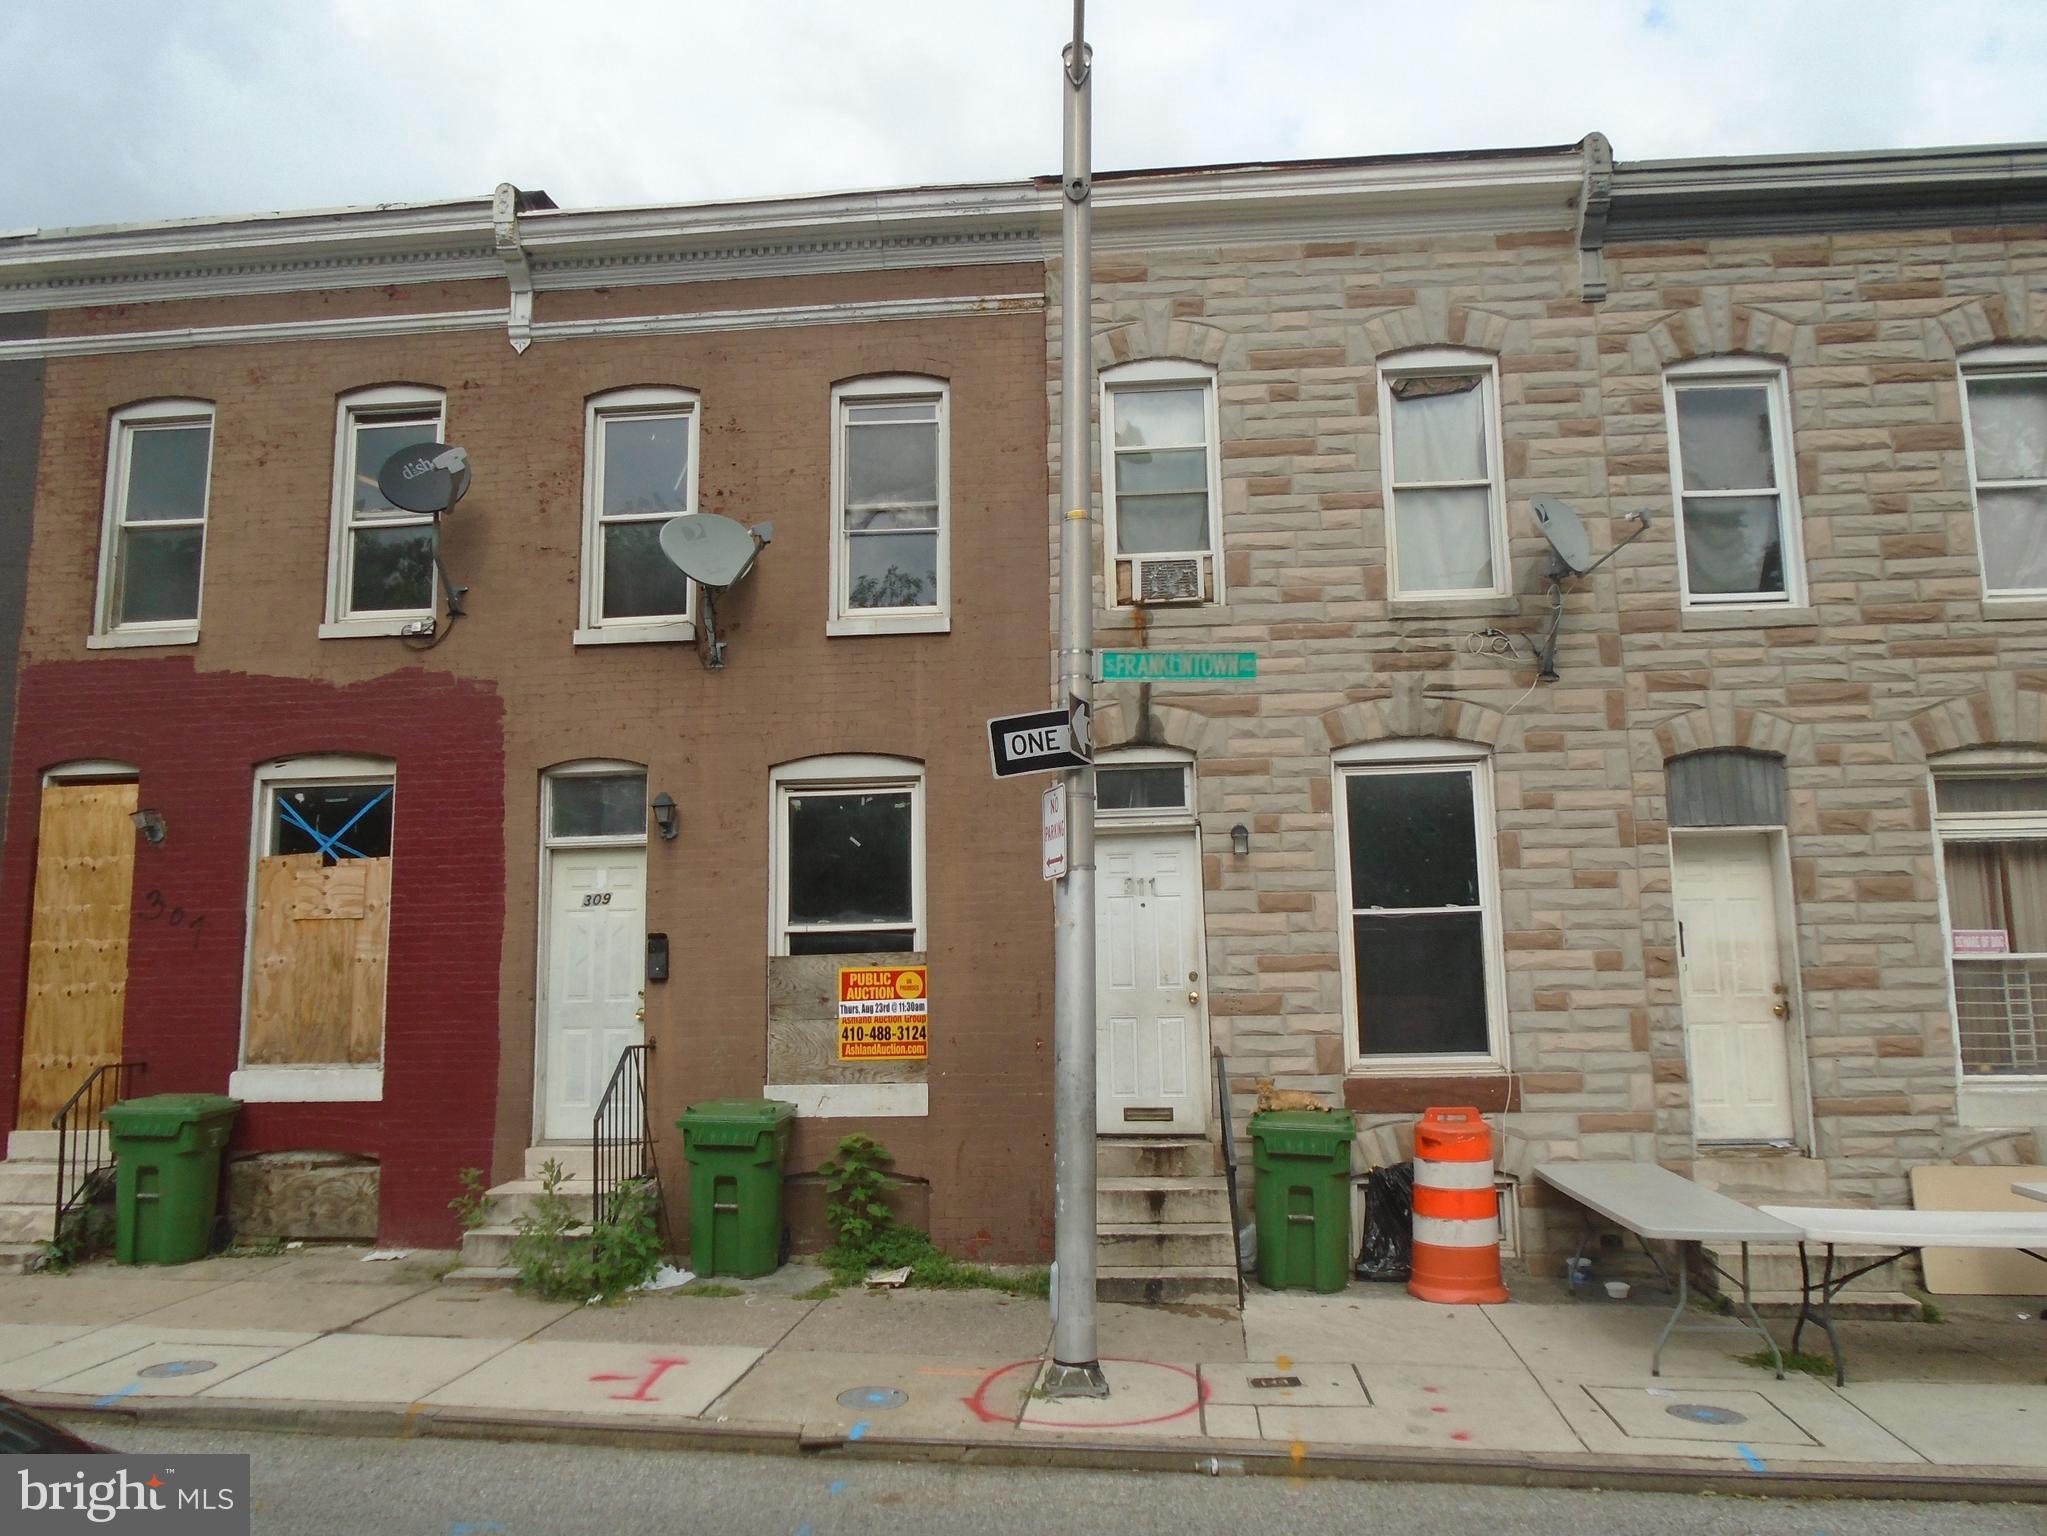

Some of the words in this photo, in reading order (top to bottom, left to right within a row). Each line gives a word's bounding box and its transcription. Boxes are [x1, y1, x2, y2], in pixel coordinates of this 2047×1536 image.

[402, 458, 433, 480] dish
[1106, 659, 1116, 672] S
[1116, 654, 1239, 676] FRANKLINTOWN
[1012, 729, 1060, 756] ONE
[1050, 798, 1059, 814] NO
[1044, 821, 1065, 843] PARKING
[583, 892, 612, 907] 309
[849, 972, 891, 986] PUBLIC
[846, 986, 894, 1000] AUCTION
[840, 1003, 861, 1015] Thurs,
[861, 1003, 874, 1014] Aug
[875, 1003, 890, 1013] 23rd
[891, 1002, 898, 1013] @
[899, 1001, 925, 1012] 11:30am
[841, 1025, 927, 1041] 410-488-3124
[845, 1042, 925, 1056] AshlandAuction.com
